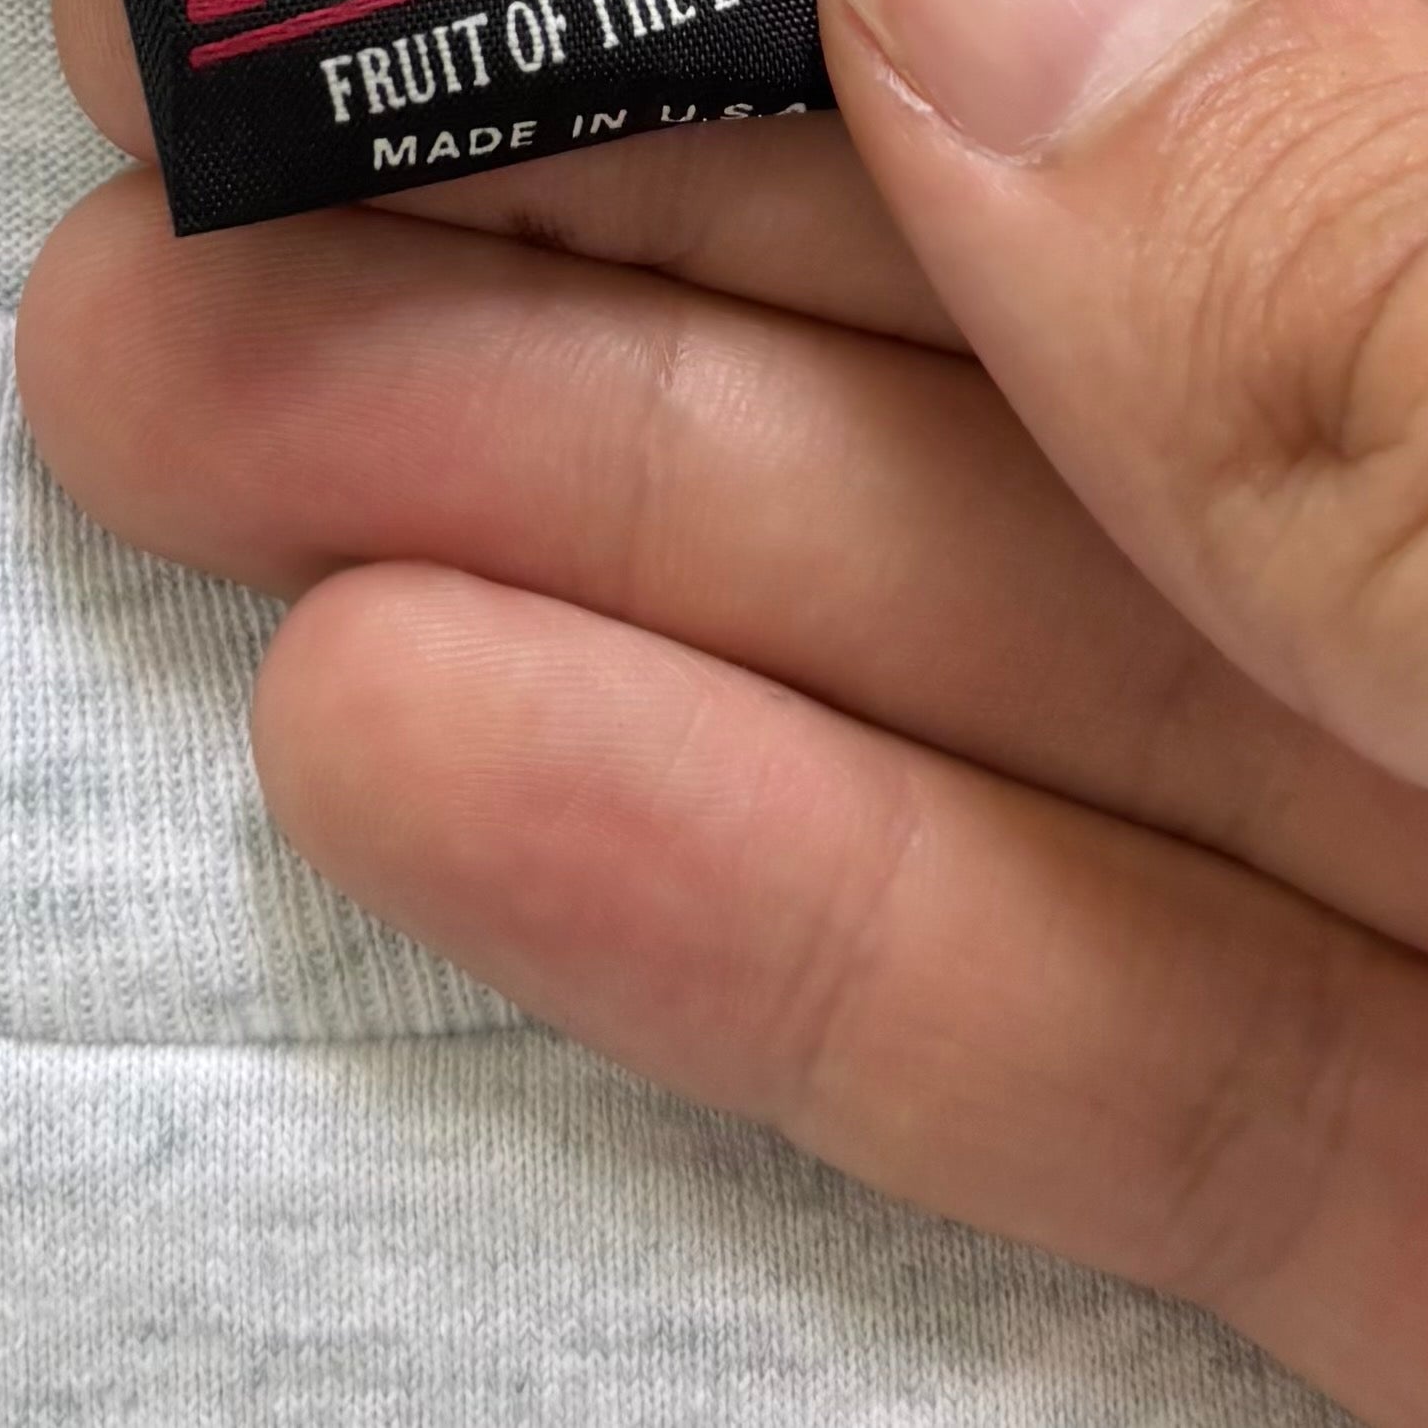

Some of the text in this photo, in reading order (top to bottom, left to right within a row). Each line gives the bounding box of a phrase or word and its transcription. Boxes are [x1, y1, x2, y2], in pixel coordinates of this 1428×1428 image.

[320, 14, 489, 123] FRUIT
[372, 120, 538, 171] MADE
[572, 108, 628, 138] IN
